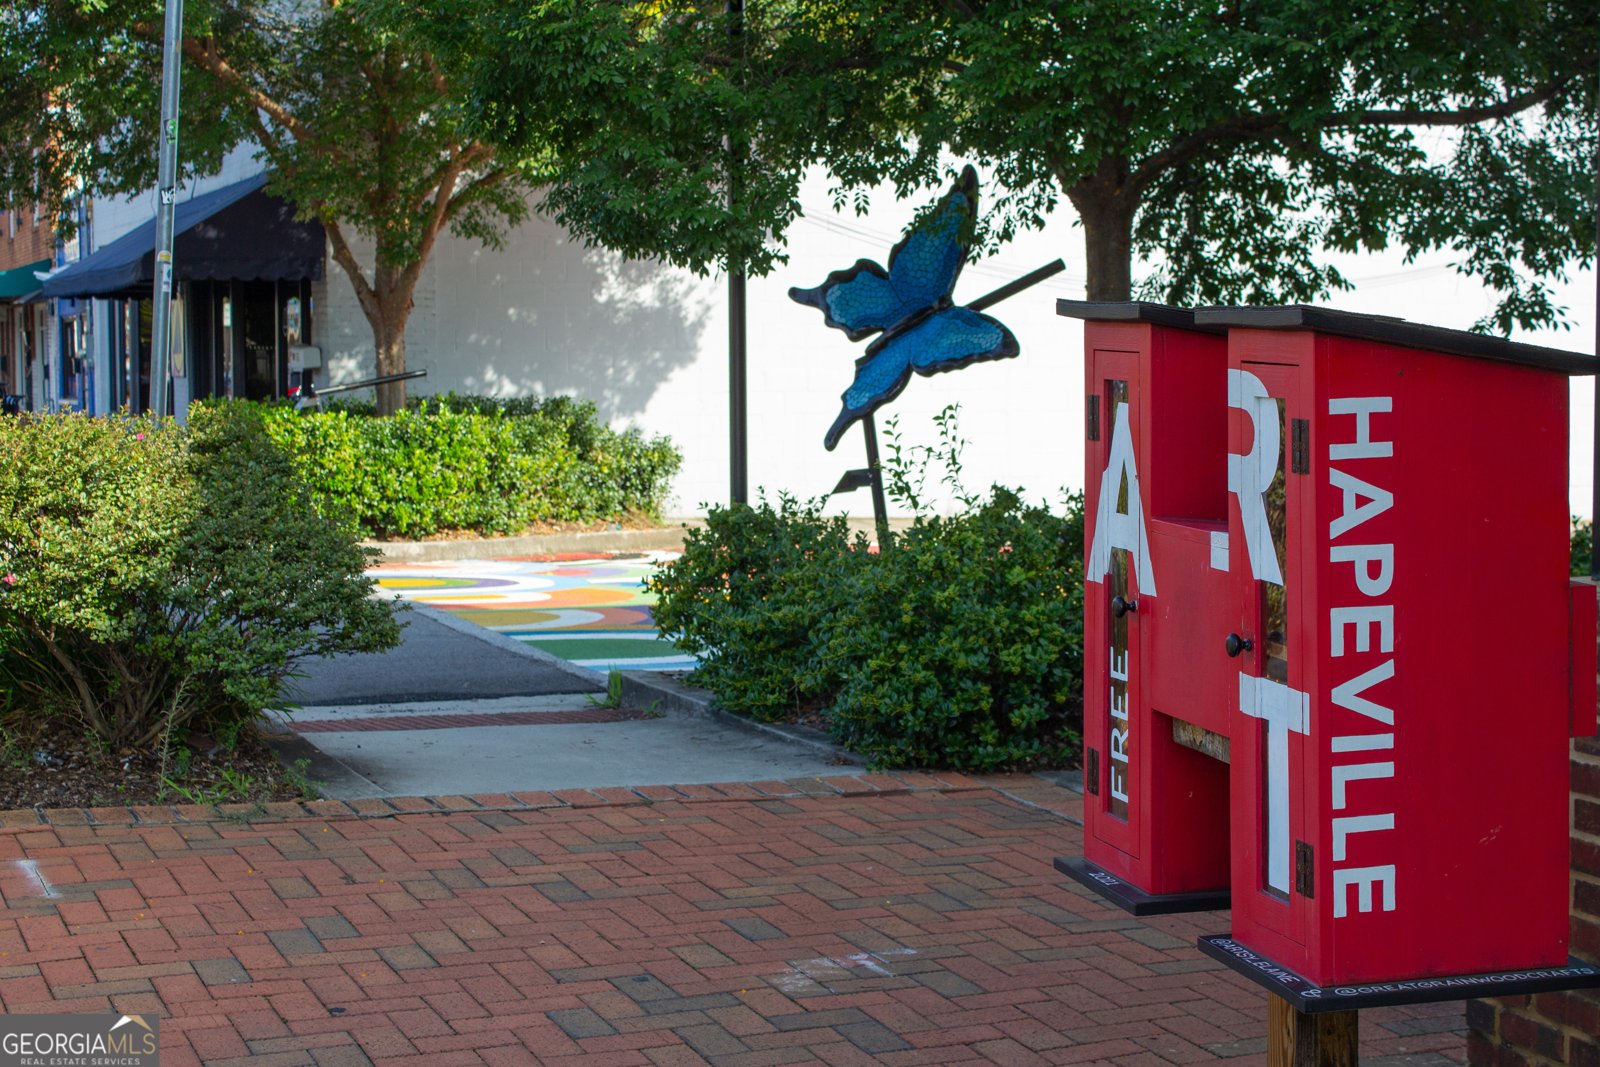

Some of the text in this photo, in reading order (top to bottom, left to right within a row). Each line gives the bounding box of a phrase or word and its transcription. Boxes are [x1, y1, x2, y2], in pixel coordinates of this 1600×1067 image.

[1111, 648, 1129, 804] FREE
[1329, 396, 1396, 919] HAPEVILLE
[1334, 967, 1595, 997] @GREATGRAINWOODCRAFTS
